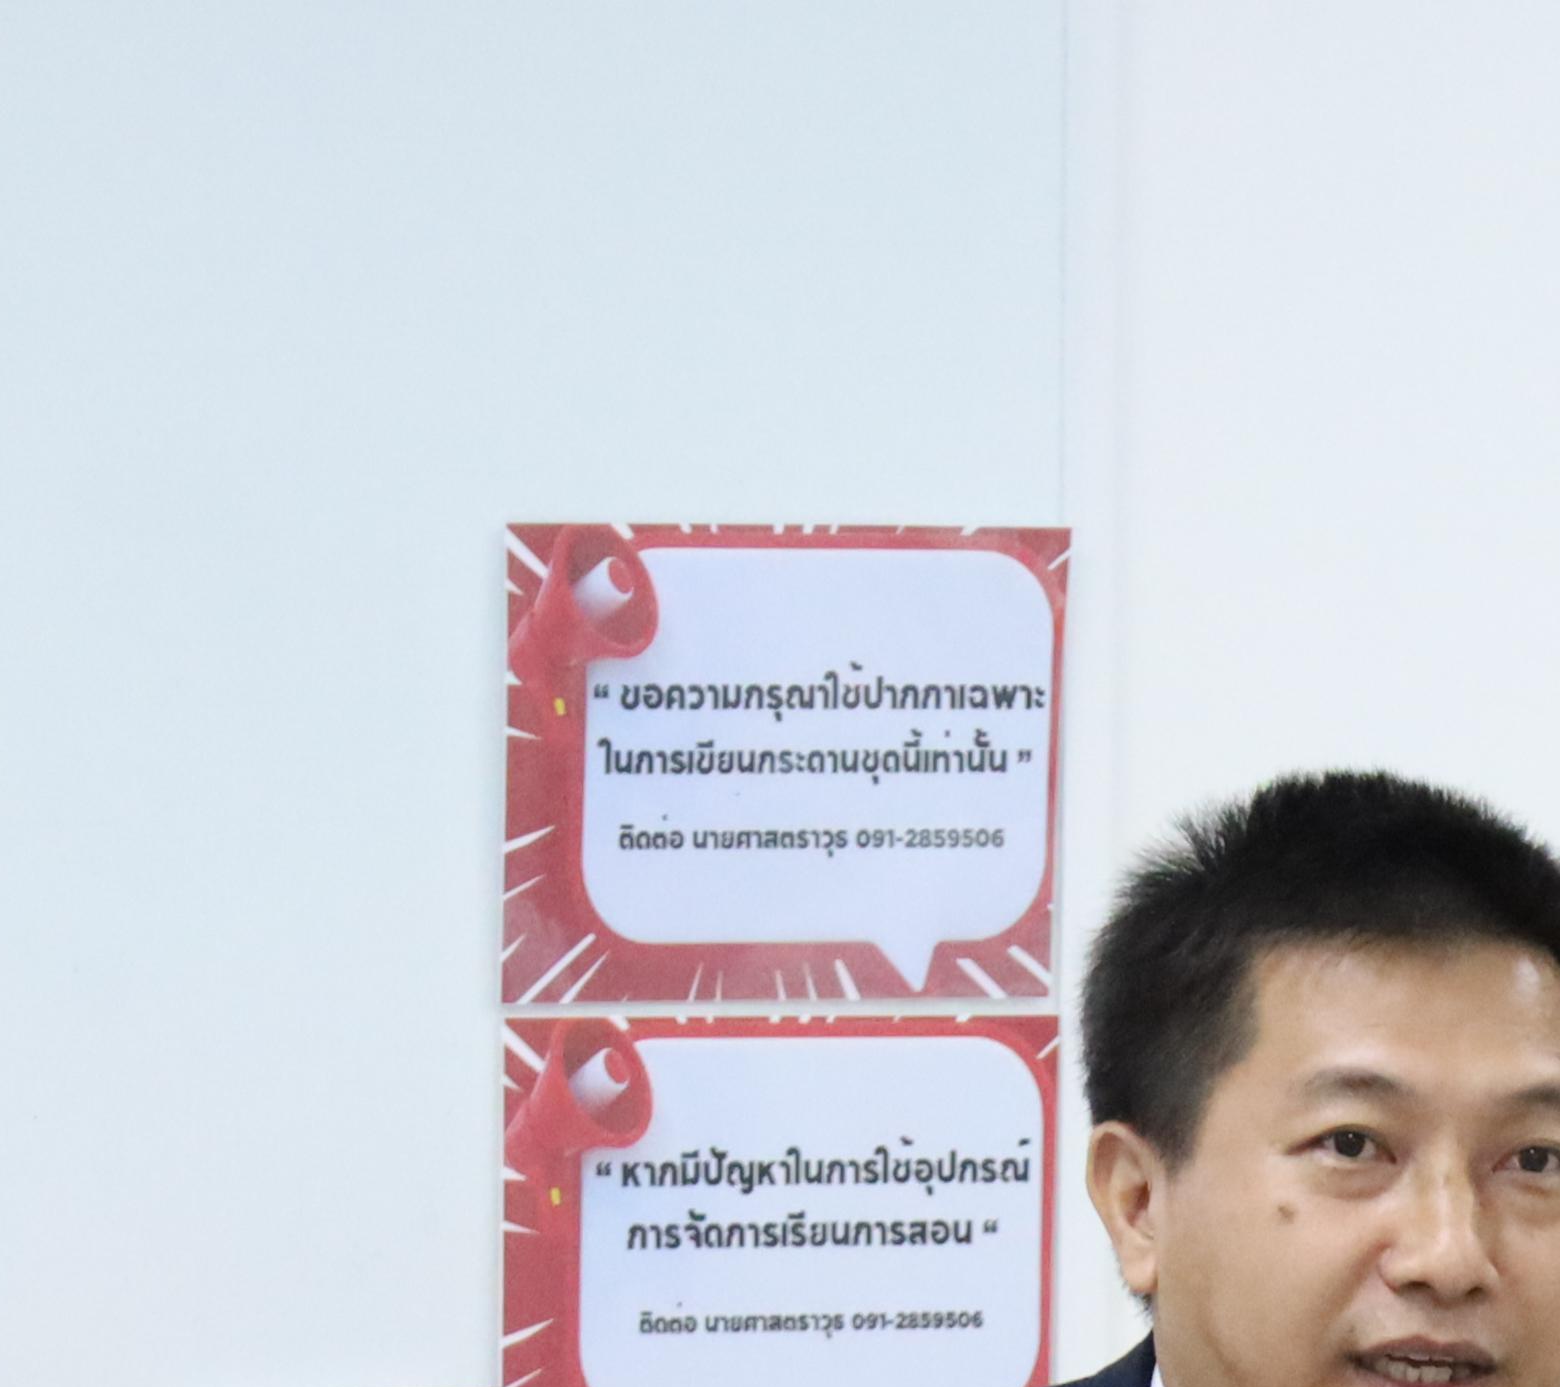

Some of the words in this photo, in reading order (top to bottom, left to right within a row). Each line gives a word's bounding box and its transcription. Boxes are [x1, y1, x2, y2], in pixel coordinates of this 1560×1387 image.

[618, 815, 684, 850] ติดต่อ
[856, 828, 1004, 849] 091-2859506
[852, 1311, 983, 1331] 091-2859506
